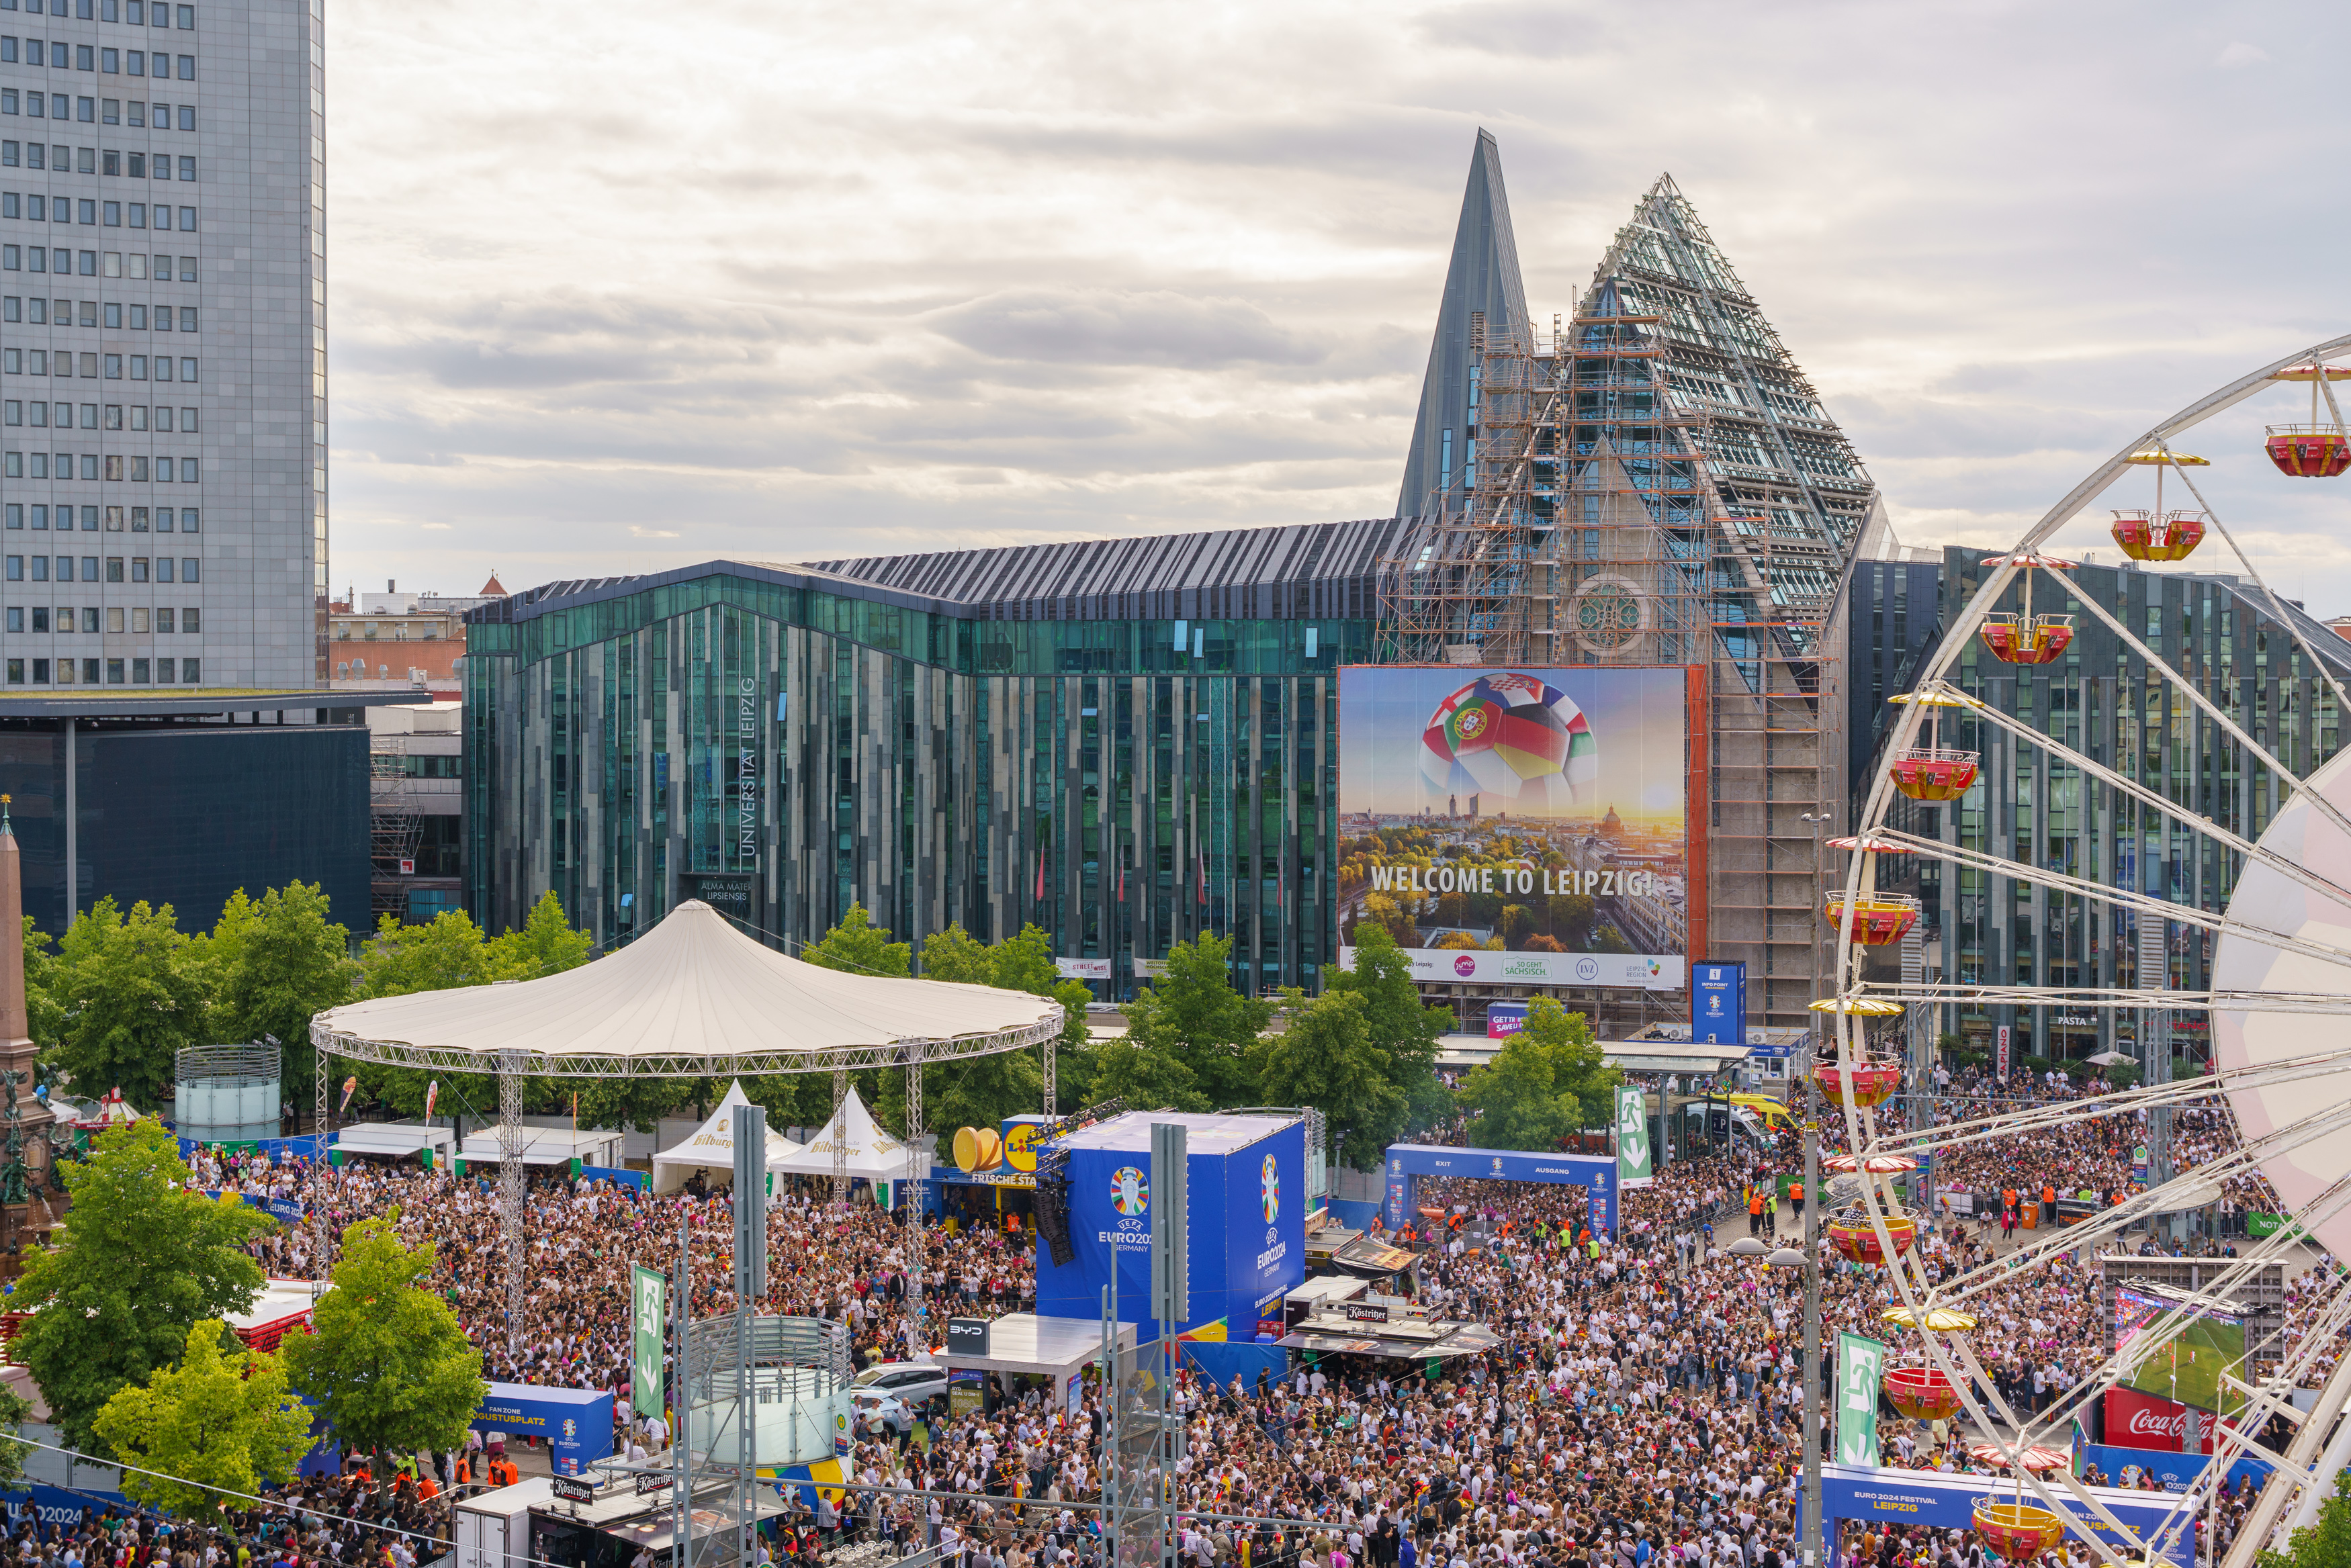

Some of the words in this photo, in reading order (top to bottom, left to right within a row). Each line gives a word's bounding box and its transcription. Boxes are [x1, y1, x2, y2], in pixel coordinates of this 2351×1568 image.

[741, 677, 755, 739] LEIPZIG
[741, 747, 756, 857] UNIVERSITÄT
[701, 882, 725, 890] ALMA
[727, 882, 752, 891] MATER
[1371, 866, 1493, 894] WELCOME
[1502, 868, 1534, 894] TO
[1544, 870, 1653, 897] LEIPZIG!
[707, 892, 747, 901] LIPSIENSIS
[1505, 966, 1548, 976] SÄCHSISCH.
[1580, 964, 1595, 974] LVZ
[1496, 1023, 1513, 1031] SAVE
[2058, 1016, 2087, 1026] PASTA
[2145, 1019, 2208, 1031] VIANO
[1720, 1118, 1726, 1129] P
[692, 1134, 734, 1149] Bitburg
[972, 1174, 1016, 1185] FRISCHE
[1018, 1176, 1036, 1186] STA
[269, 1203, 290, 1214] EURO
[290, 1207, 301, 1217] 202
[1118, 1220, 1142, 1231] UEFA
[1098, 1231, 1151, 1245] EURO20
[1266, 1230, 1277, 1246] UEFA
[1257, 1240, 1286, 1270] EURO2024
[1264, 1261, 1280, 1278] GERMANY
[1255, 1297, 1265, 1309] EURO
[1265, 1293, 1274, 1305] 2024
[1274, 1283, 1288, 1299] FESTIVAL
[1261, 1297, 1282, 1318] LEIPZIG
[1349, 1306, 1386, 1320] Köstritzer
[950, 1325, 983, 1336] BYD
[952, 1397, 975, 1409] 1080
[473, 1412, 545, 1426] UGUSTUSPLATZ
[2129, 1408, 2215, 1440] Coca-Cla
[555, 1479, 590, 1499] Köstritzer
[1854, 1491, 1877, 1500] EURO
[1877, 1493, 1899, 1502] 2024
[1900, 1495, 1938, 1505] FESTIVAL
[6, 1502, 83, 1525] UO2024
[1873, 1501, 1918, 1512] LEIPZIG
